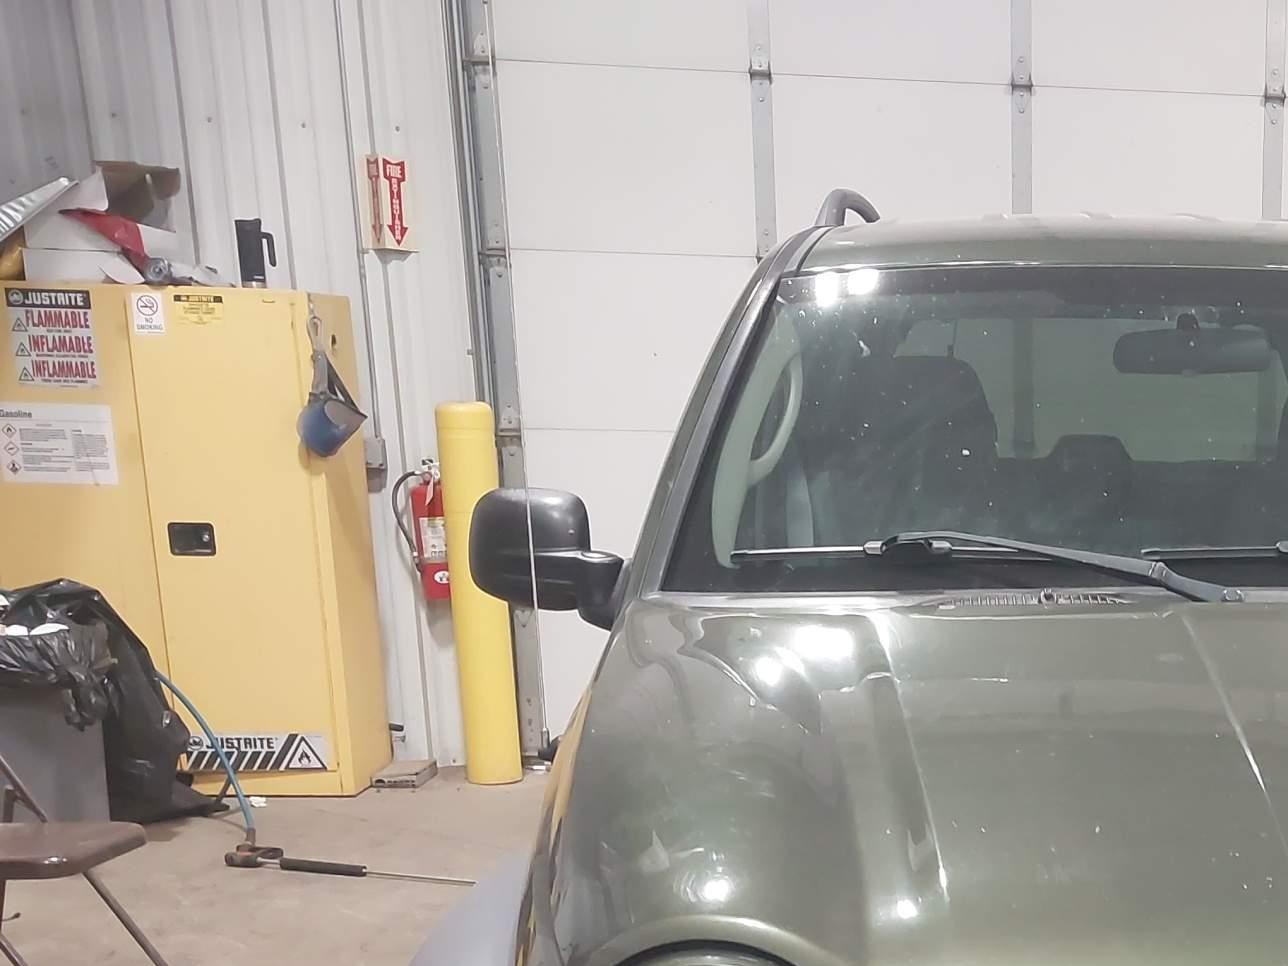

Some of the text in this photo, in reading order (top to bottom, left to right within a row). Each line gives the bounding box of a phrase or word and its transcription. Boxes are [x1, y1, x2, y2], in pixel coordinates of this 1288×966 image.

[25, 292, 85, 306] JUSTRITE
[25, 310, 90, 329] FLAMMABLE
[28, 334, 93, 354] INFLAMABLE
[31, 359, 97, 379] INFLAMMABLE
